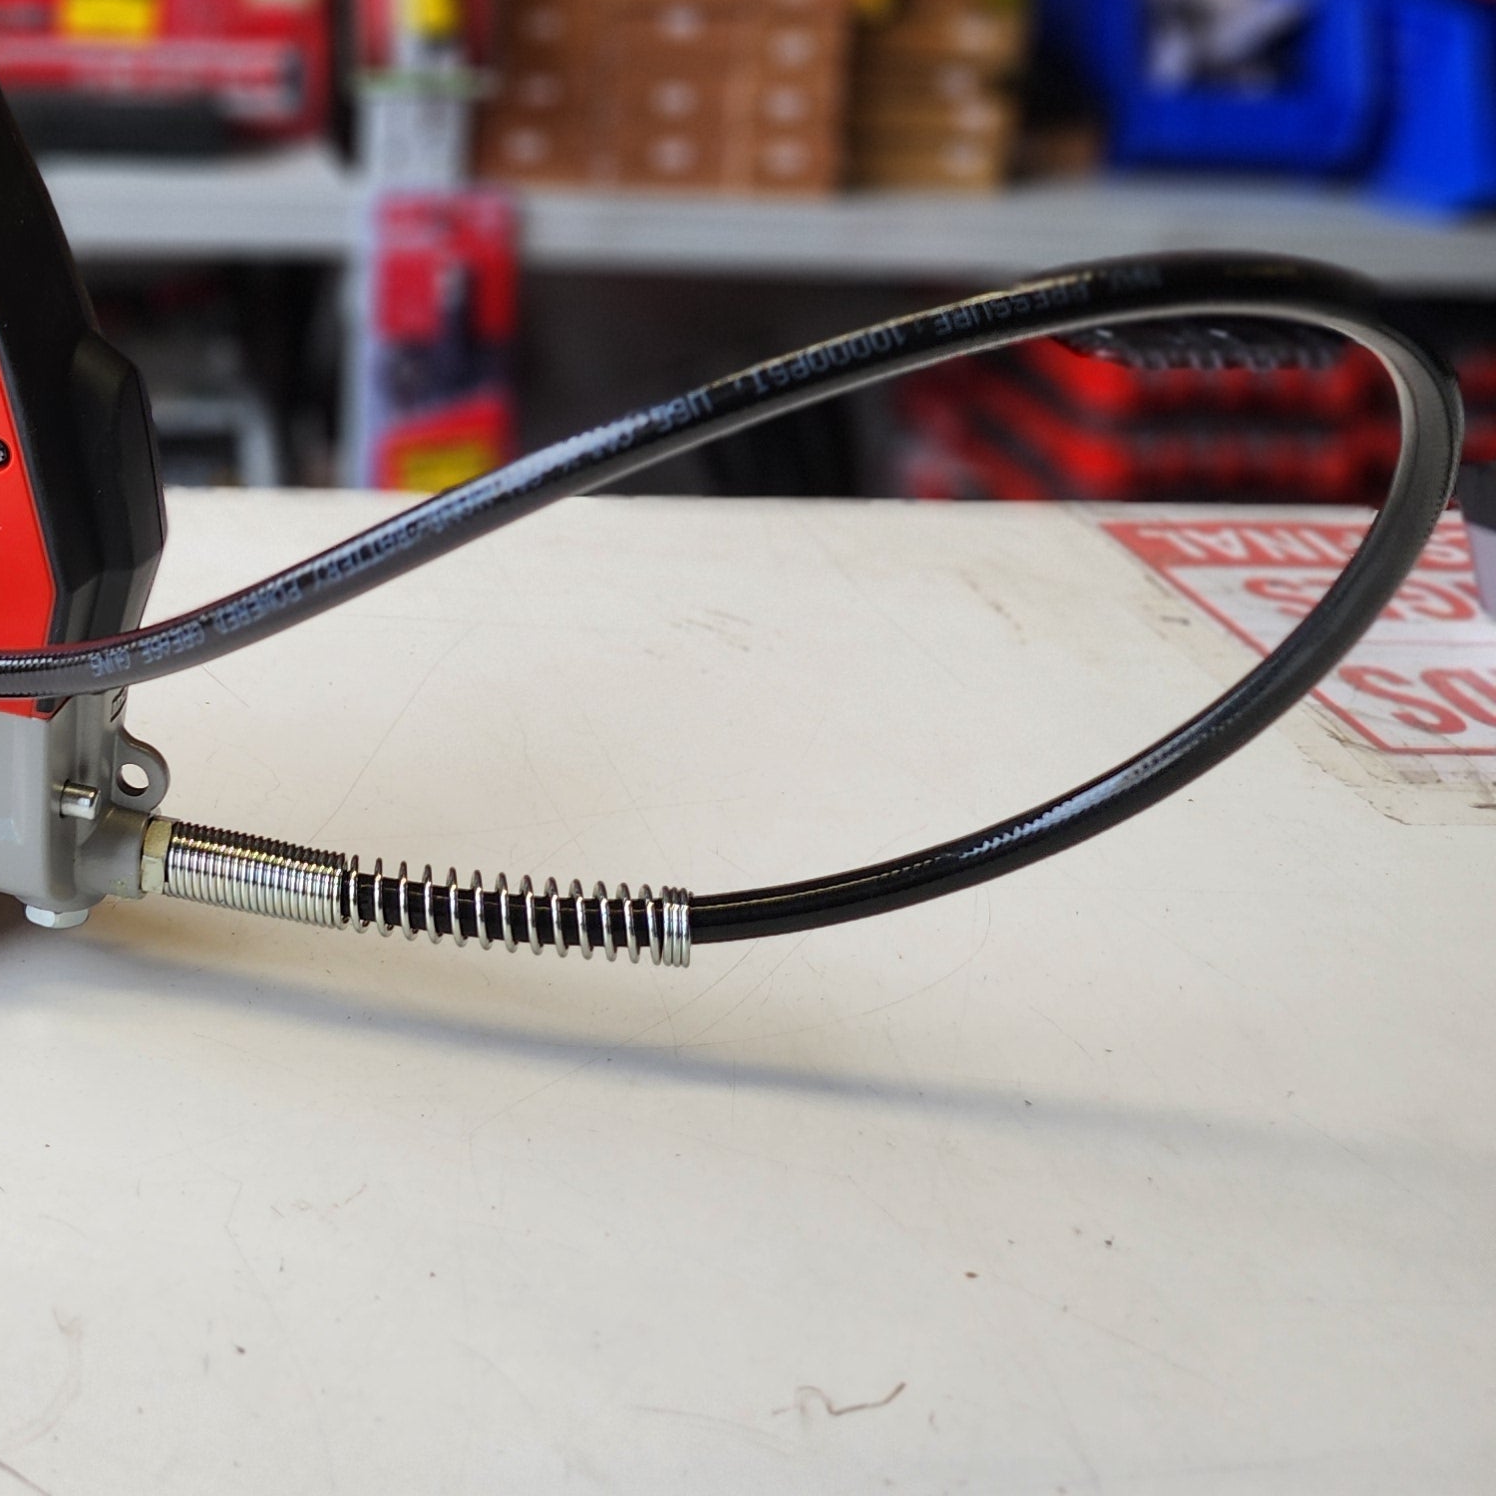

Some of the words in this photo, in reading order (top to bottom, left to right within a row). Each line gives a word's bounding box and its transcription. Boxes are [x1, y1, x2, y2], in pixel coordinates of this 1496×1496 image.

[213, 575, 302, 635] POWERED
[89, 649, 131, 677] GUNS
[140, 620, 206, 665] GREASE
